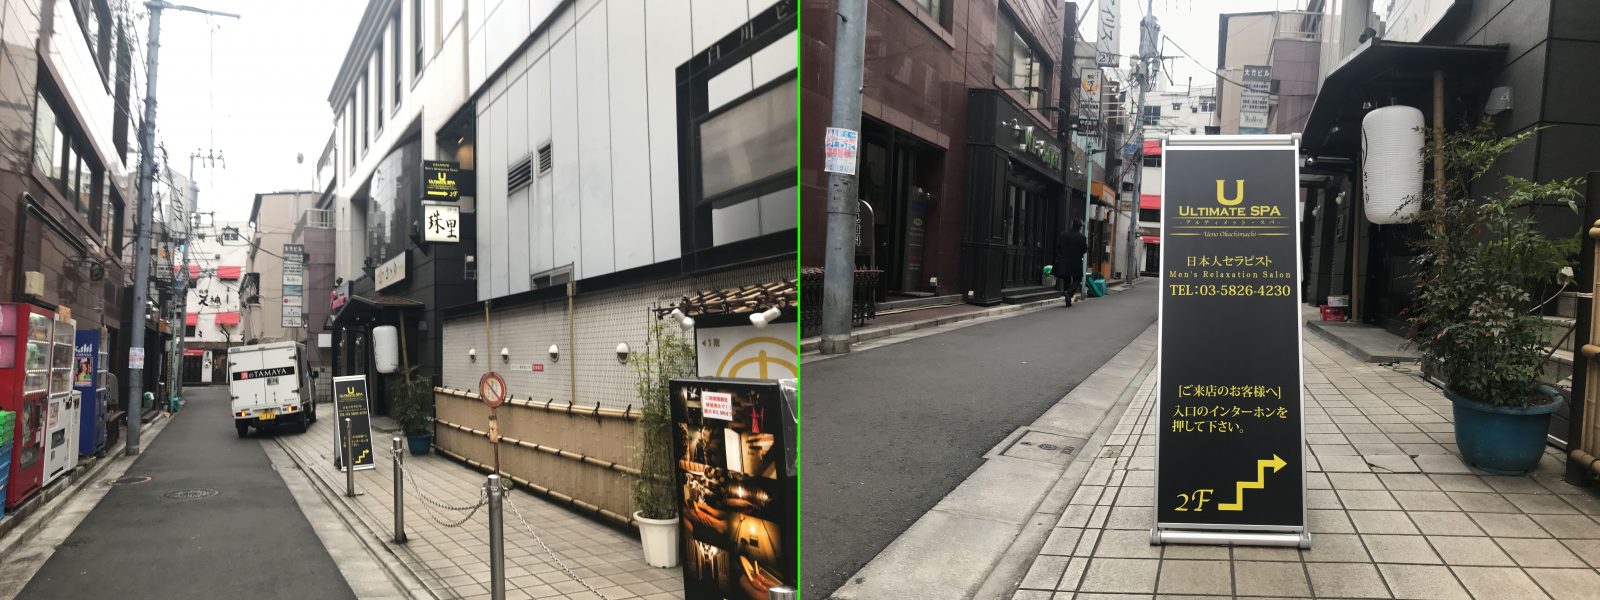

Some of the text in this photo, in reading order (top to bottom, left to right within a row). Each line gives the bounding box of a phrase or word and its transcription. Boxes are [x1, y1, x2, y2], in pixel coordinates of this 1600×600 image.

[1101, 0, 1116, 41] イリス
[1215, 179, 1245, 206] U
[1178, 205, 1281, 217] ULTIMATE SPA
[428, 210, 457, 239] 珠里
[1186, 255, 1273, 268] 日本人セラピスト
[1169, 270, 1291, 279] Men's Relaxation Salon
[254, 367, 287, 379] TAMAYA
[1172, 405, 1288, 419] 入口のインターホンを
[1171, 419, 1244, 434] 押して下さい。
[1174, 488, 1214, 512] 2F
